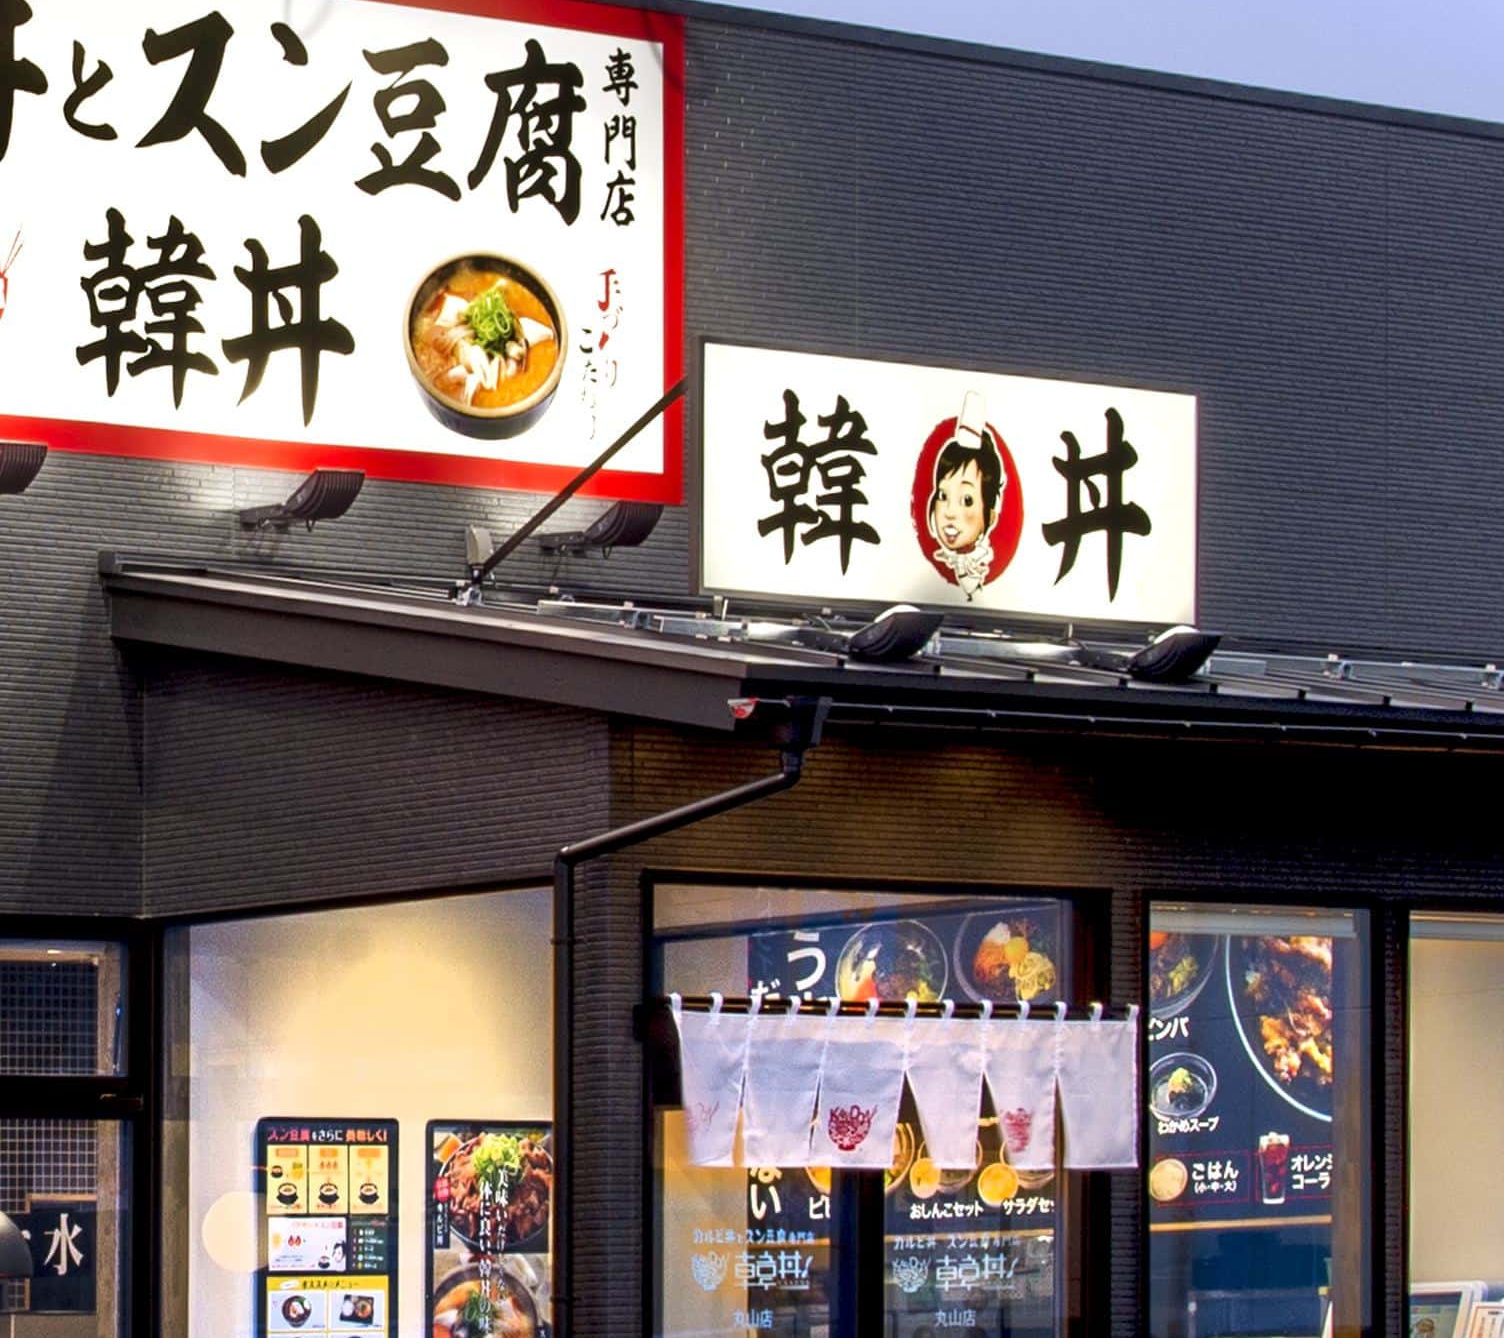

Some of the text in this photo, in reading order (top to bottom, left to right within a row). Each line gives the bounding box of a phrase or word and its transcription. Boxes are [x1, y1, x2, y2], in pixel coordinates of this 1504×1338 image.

[600, 48, 641, 228] 専門店
[75, 205, 357, 428] 韓丼
[1158, 1117, 1219, 1135] わかめスープ
[1292, 1173, 1331, 1190] コーラ
[910, 1201, 984, 1219] おしんこセット
